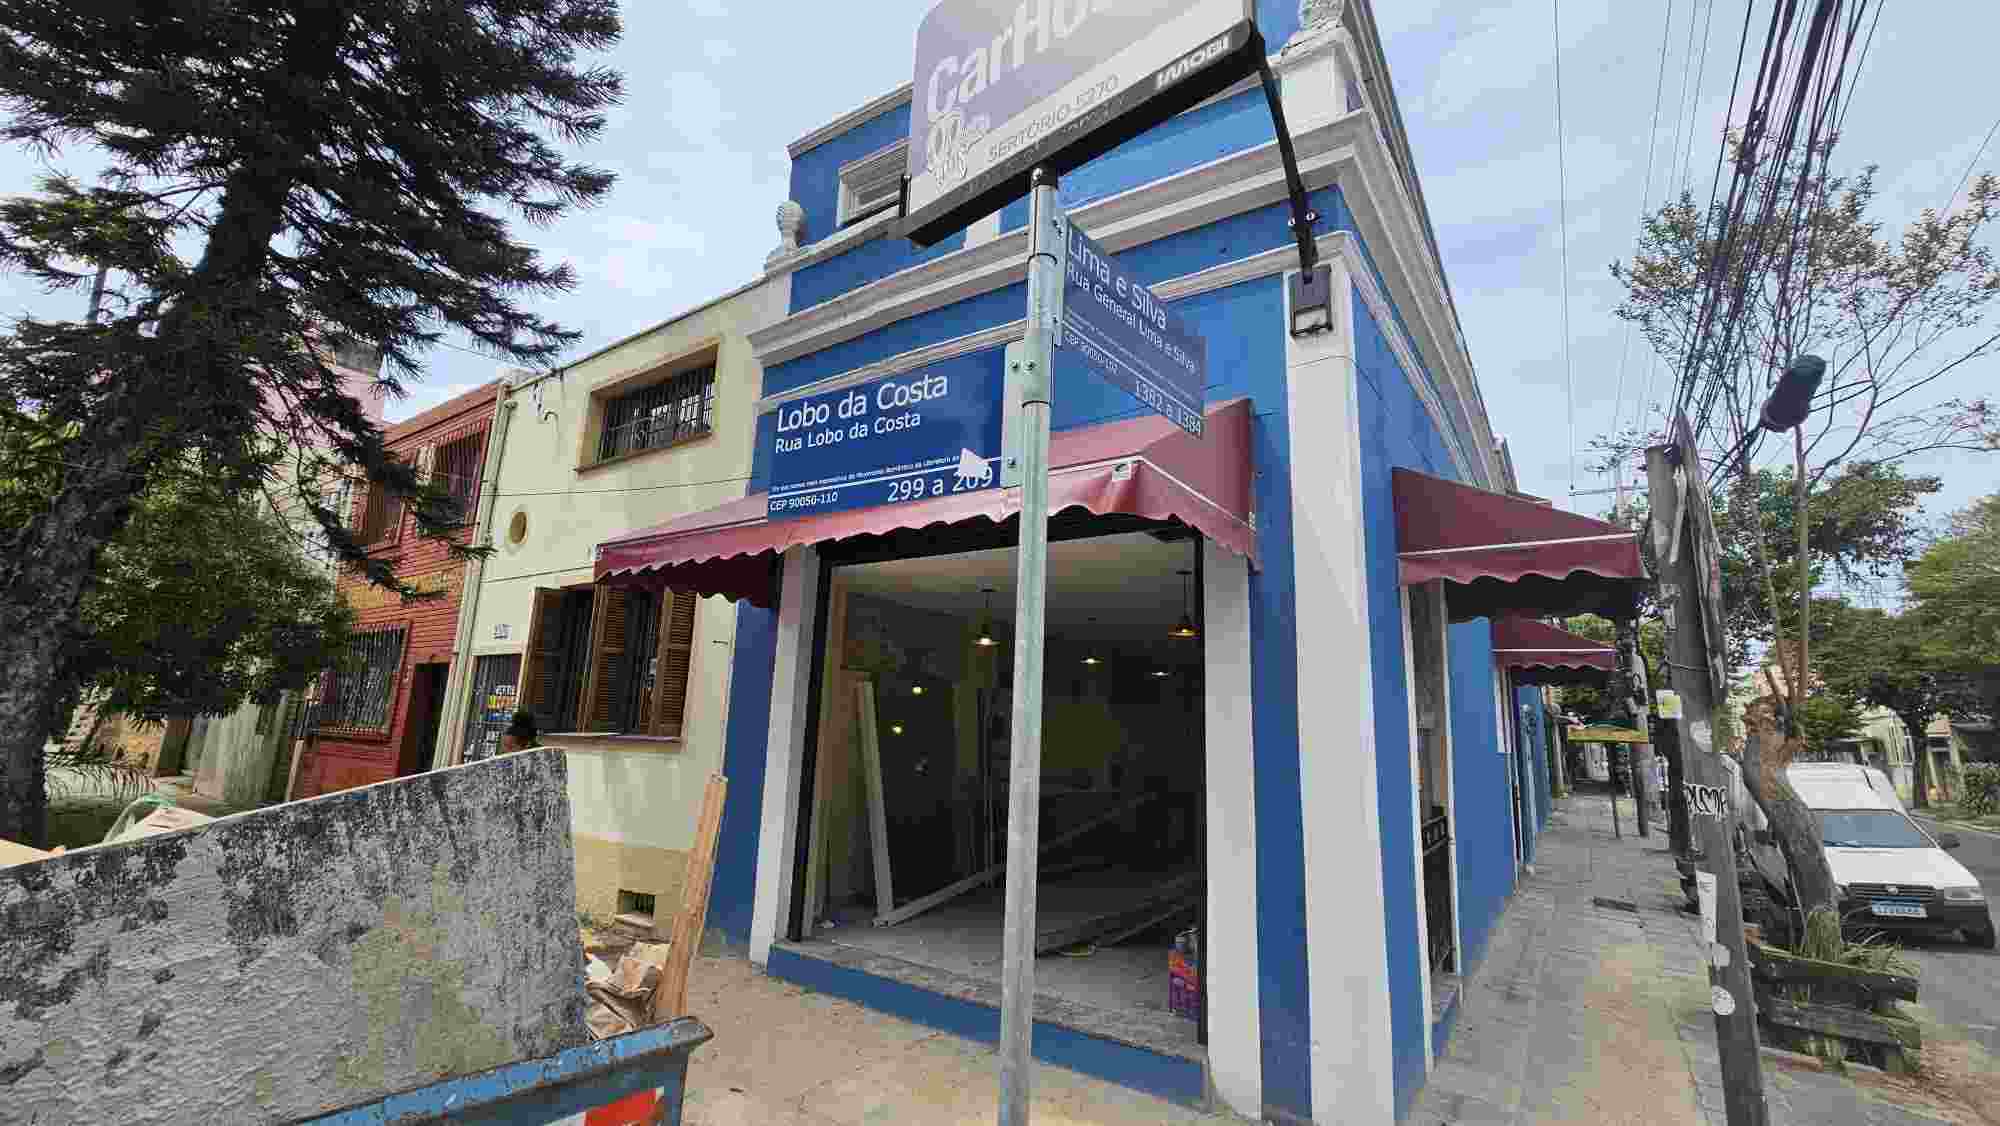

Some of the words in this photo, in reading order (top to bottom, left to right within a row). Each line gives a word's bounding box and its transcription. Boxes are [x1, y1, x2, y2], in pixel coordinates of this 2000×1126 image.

[928, 0, 1108, 113] CarHo
[1069, 228, 1110, 283] Lima
[1116, 277, 1128, 297] e
[1131, 284, 1167, 329] Silva
[1067, 263, 1090, 293] Rua
[1094, 285, 1137, 329] General
[1139, 318, 1162, 350] Lima
[1174, 346, 1195, 372] Silva
[775, 435, 802, 454] Rua
[807, 428, 844, 449] Lobo
[849, 422, 868, 440] da
[874, 411, 921, 435] Costa
[776, 401, 830, 433] Lobo
[838, 392, 867, 418] da
[877, 374, 949, 410] Costa
[769, 497, 786, 512] CEP
[788, 490, 839, 510] 90050-110
[887, 478, 925, 502] 299
[932, 478, 944, 496] a
